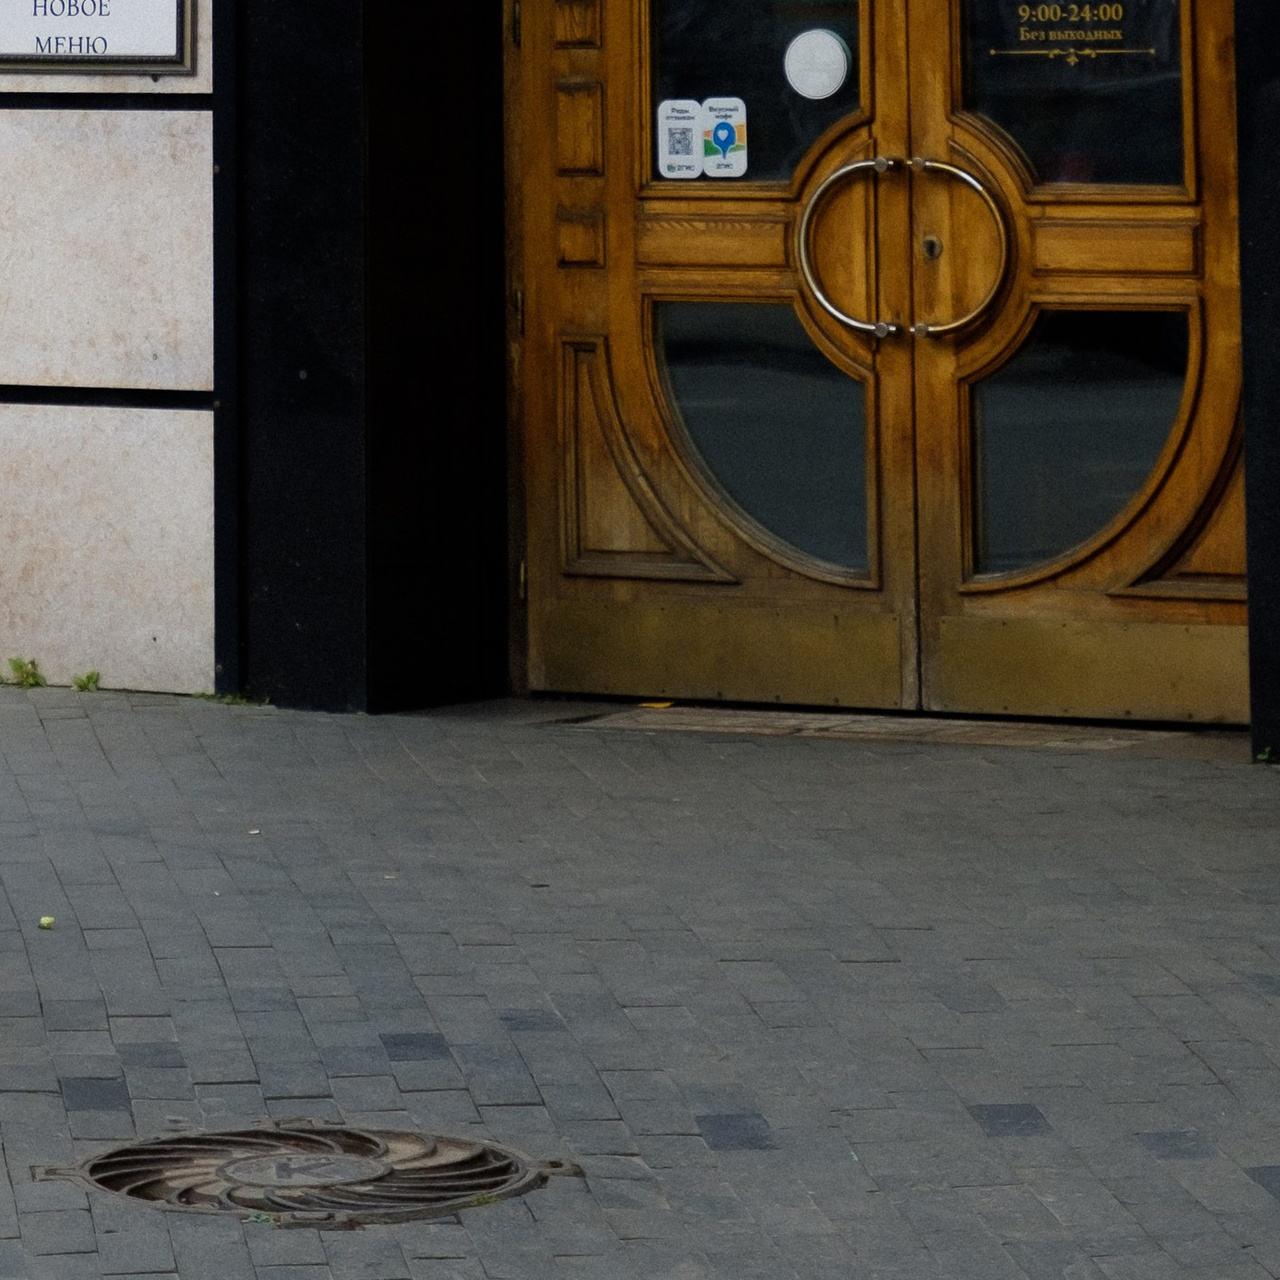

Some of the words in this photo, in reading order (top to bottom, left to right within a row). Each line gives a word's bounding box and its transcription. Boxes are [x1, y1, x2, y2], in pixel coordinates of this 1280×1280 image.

[1018, 3, 1124, 23] 9:00-24:00
[1020, 27, 1046, 41] Без
[1048, 28, 1123, 41] выходных
[35, 36, 108, 55] МЕНЮ
